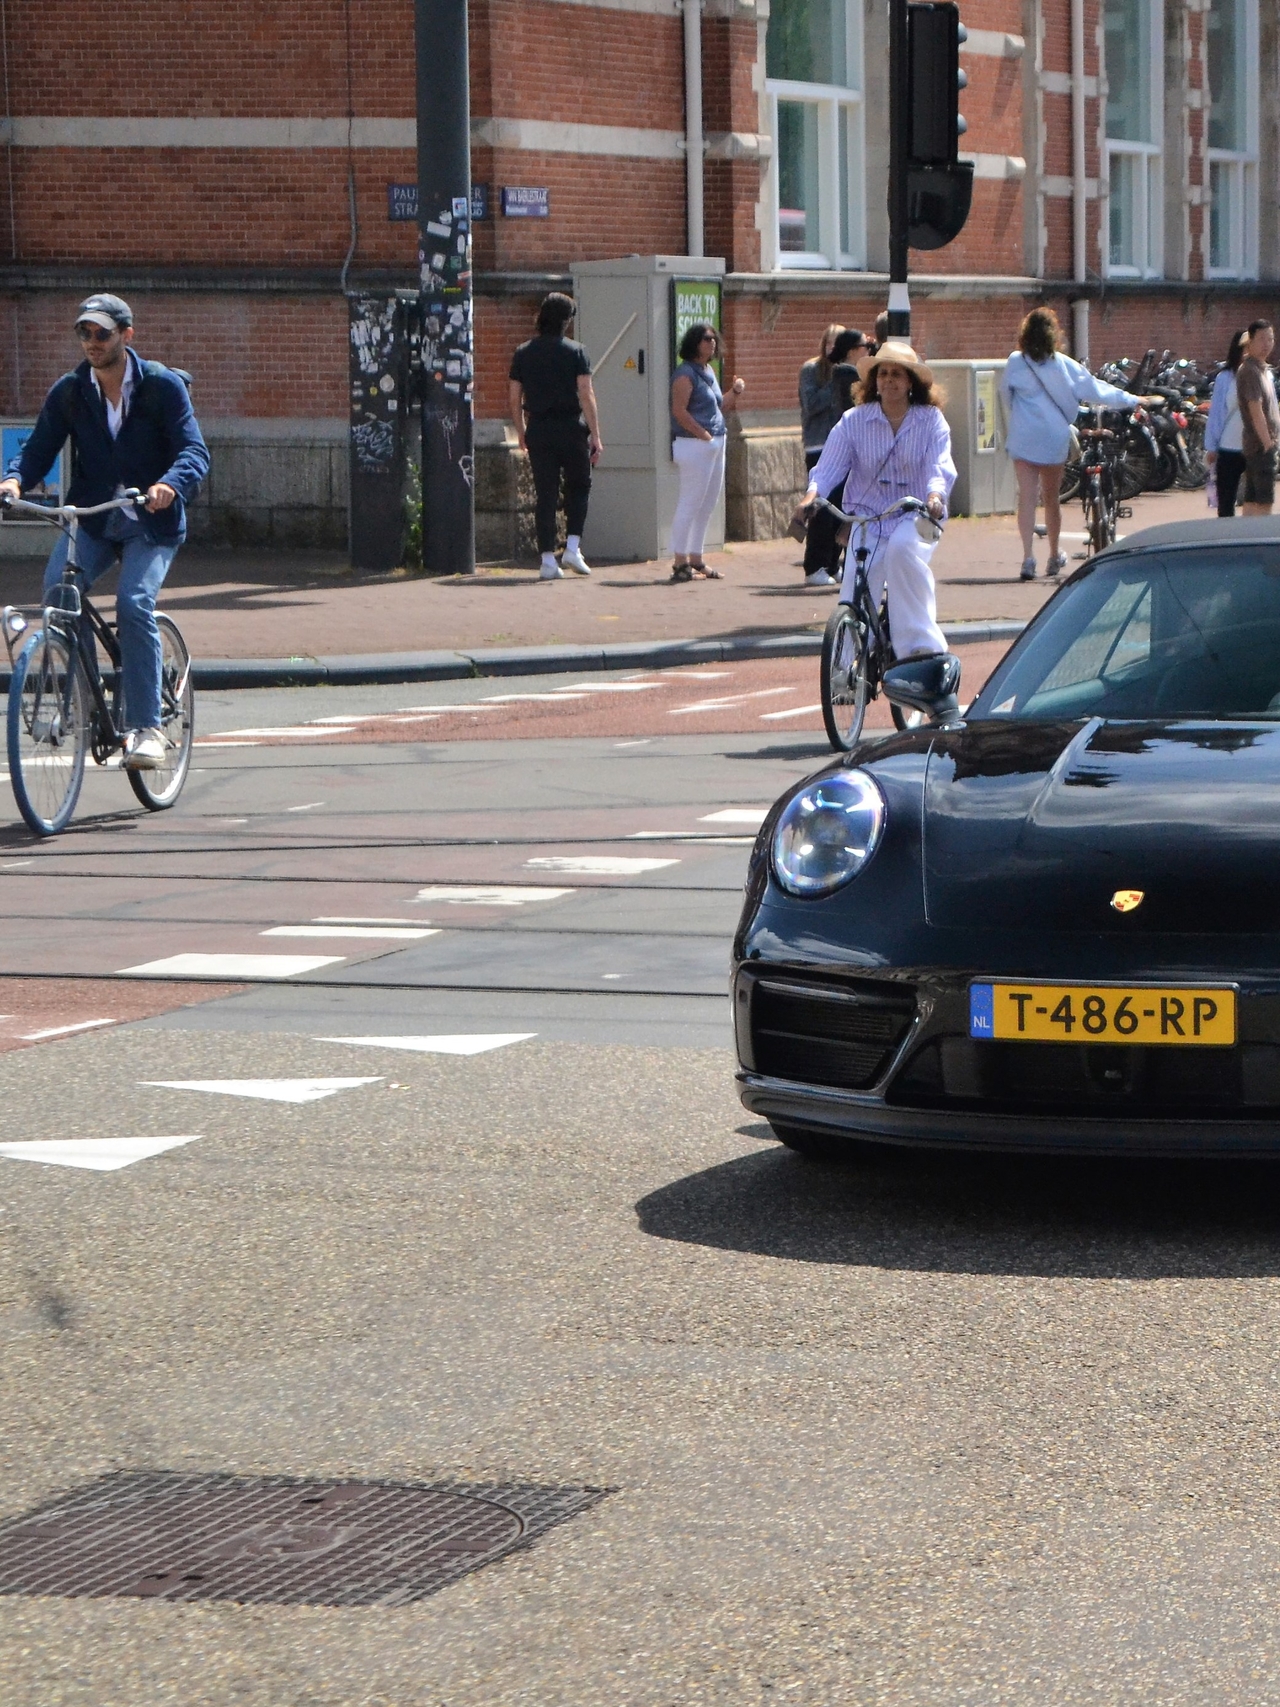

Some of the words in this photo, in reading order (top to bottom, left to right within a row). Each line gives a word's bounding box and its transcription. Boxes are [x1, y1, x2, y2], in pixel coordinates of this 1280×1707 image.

[678, 293, 702, 314] BACK
[704, 294, 716, 314] TO
[973, 1015, 990, 1029] NL
[1009, 993, 1218, 1036] T-486-RP
